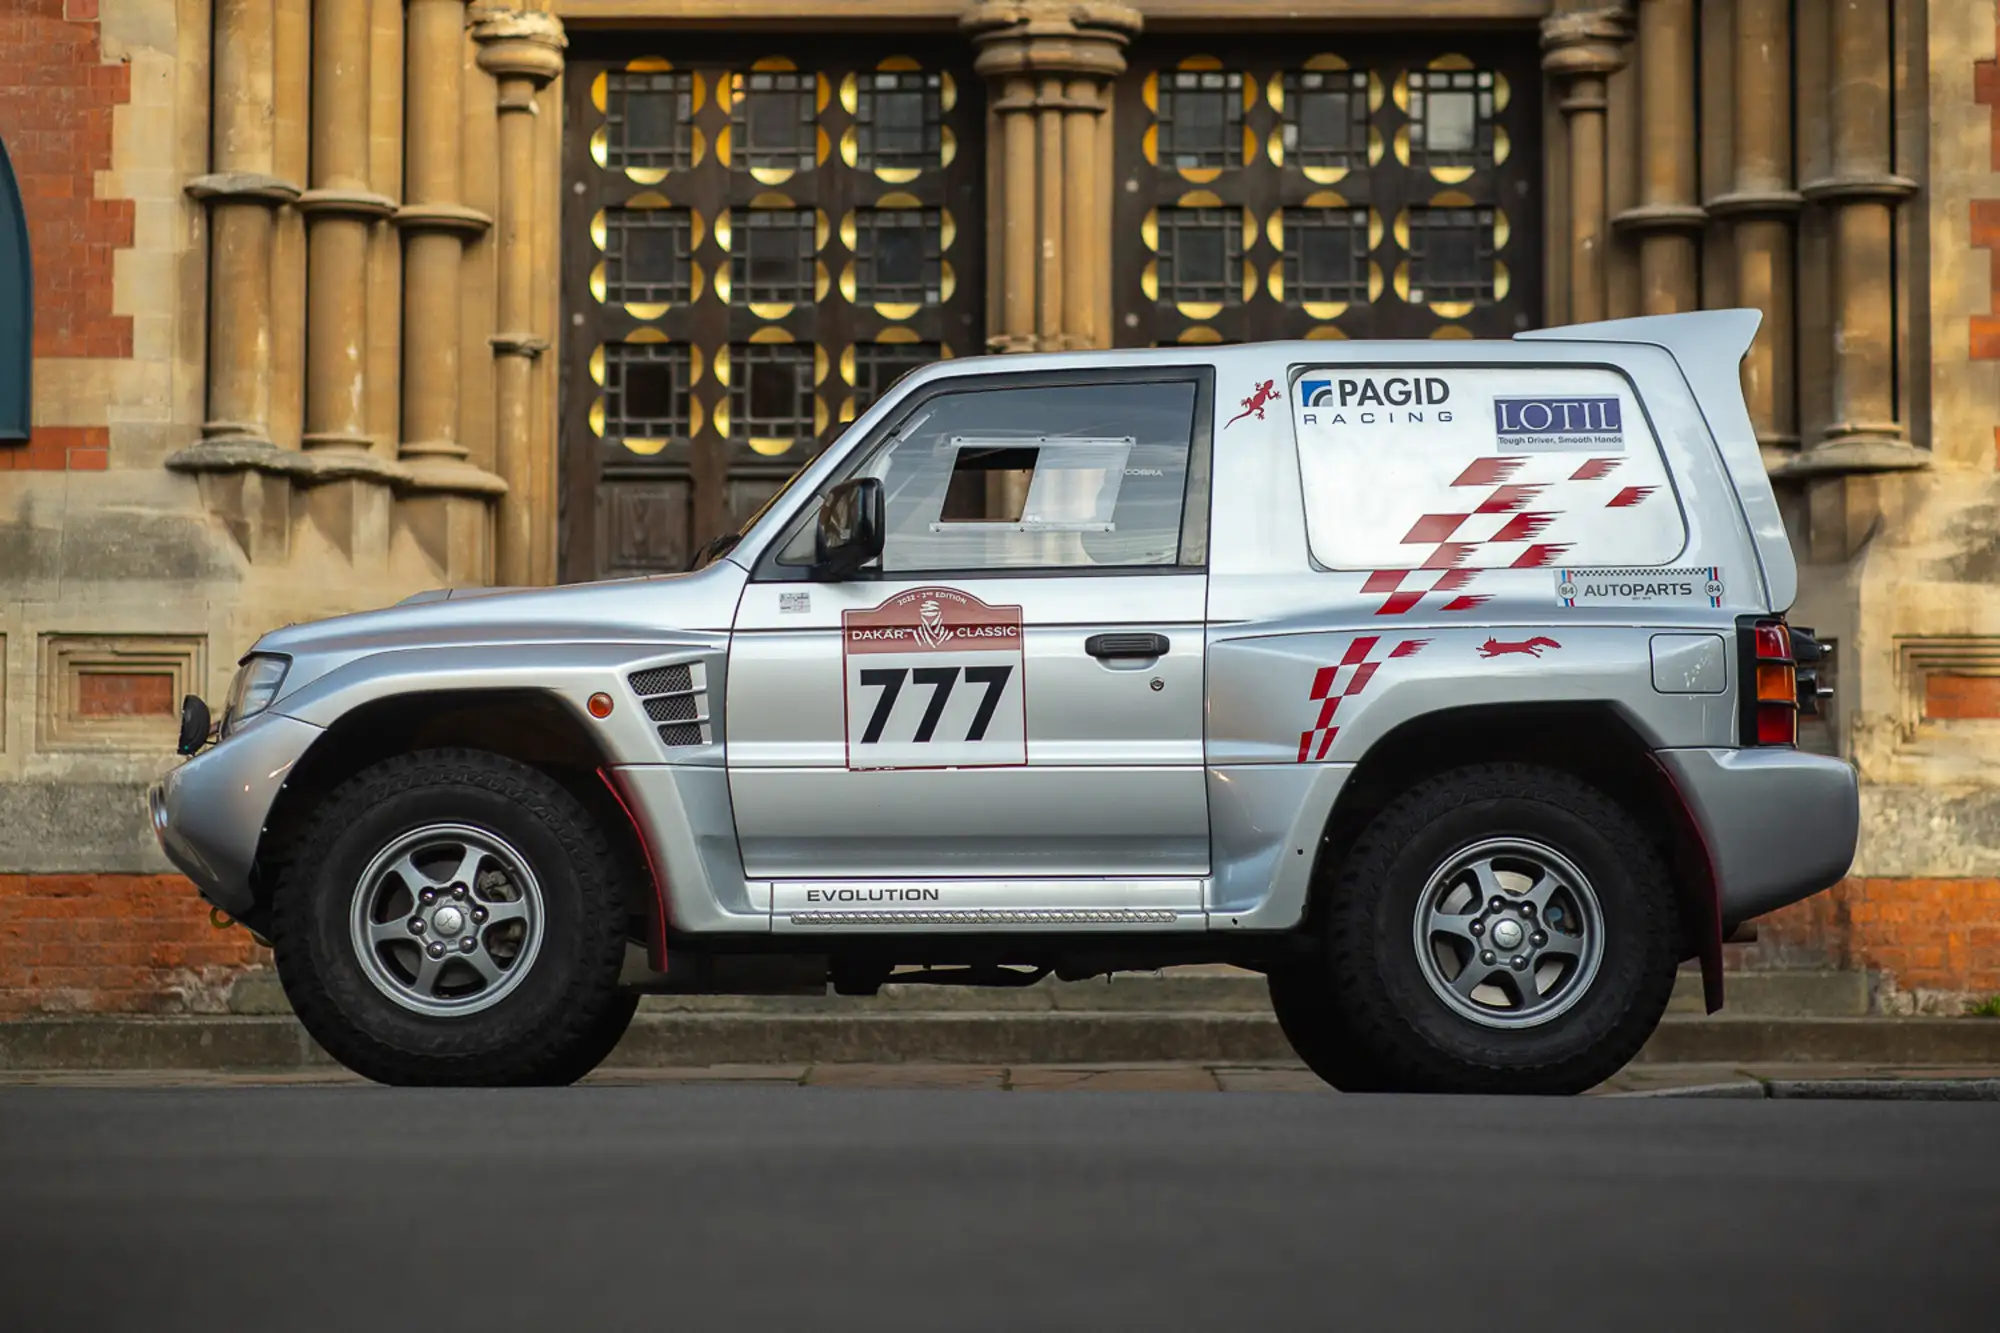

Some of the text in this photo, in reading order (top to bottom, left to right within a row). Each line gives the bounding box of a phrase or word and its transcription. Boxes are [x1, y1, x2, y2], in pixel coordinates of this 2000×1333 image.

[1338, 377, 1450, 407] PAGID
[1303, 411, 1453, 425] RACING
[1498, 402, 1619, 431] LOTIL
[1498, 435, 1623, 446] Tough Driver, Smooth Hands
[1124, 468, 1164, 477] COBRA
[1561, 583, 1721, 597] 84 AUTOPARTS 84
[897, 594, 916, 606] 2022
[935, 591, 968, 605] EDITION
[852, 626, 1018, 641] DAKAR CLASSIC
[860, 665, 1014, 745] 777
[807, 888, 939, 902] EVOLUTION
